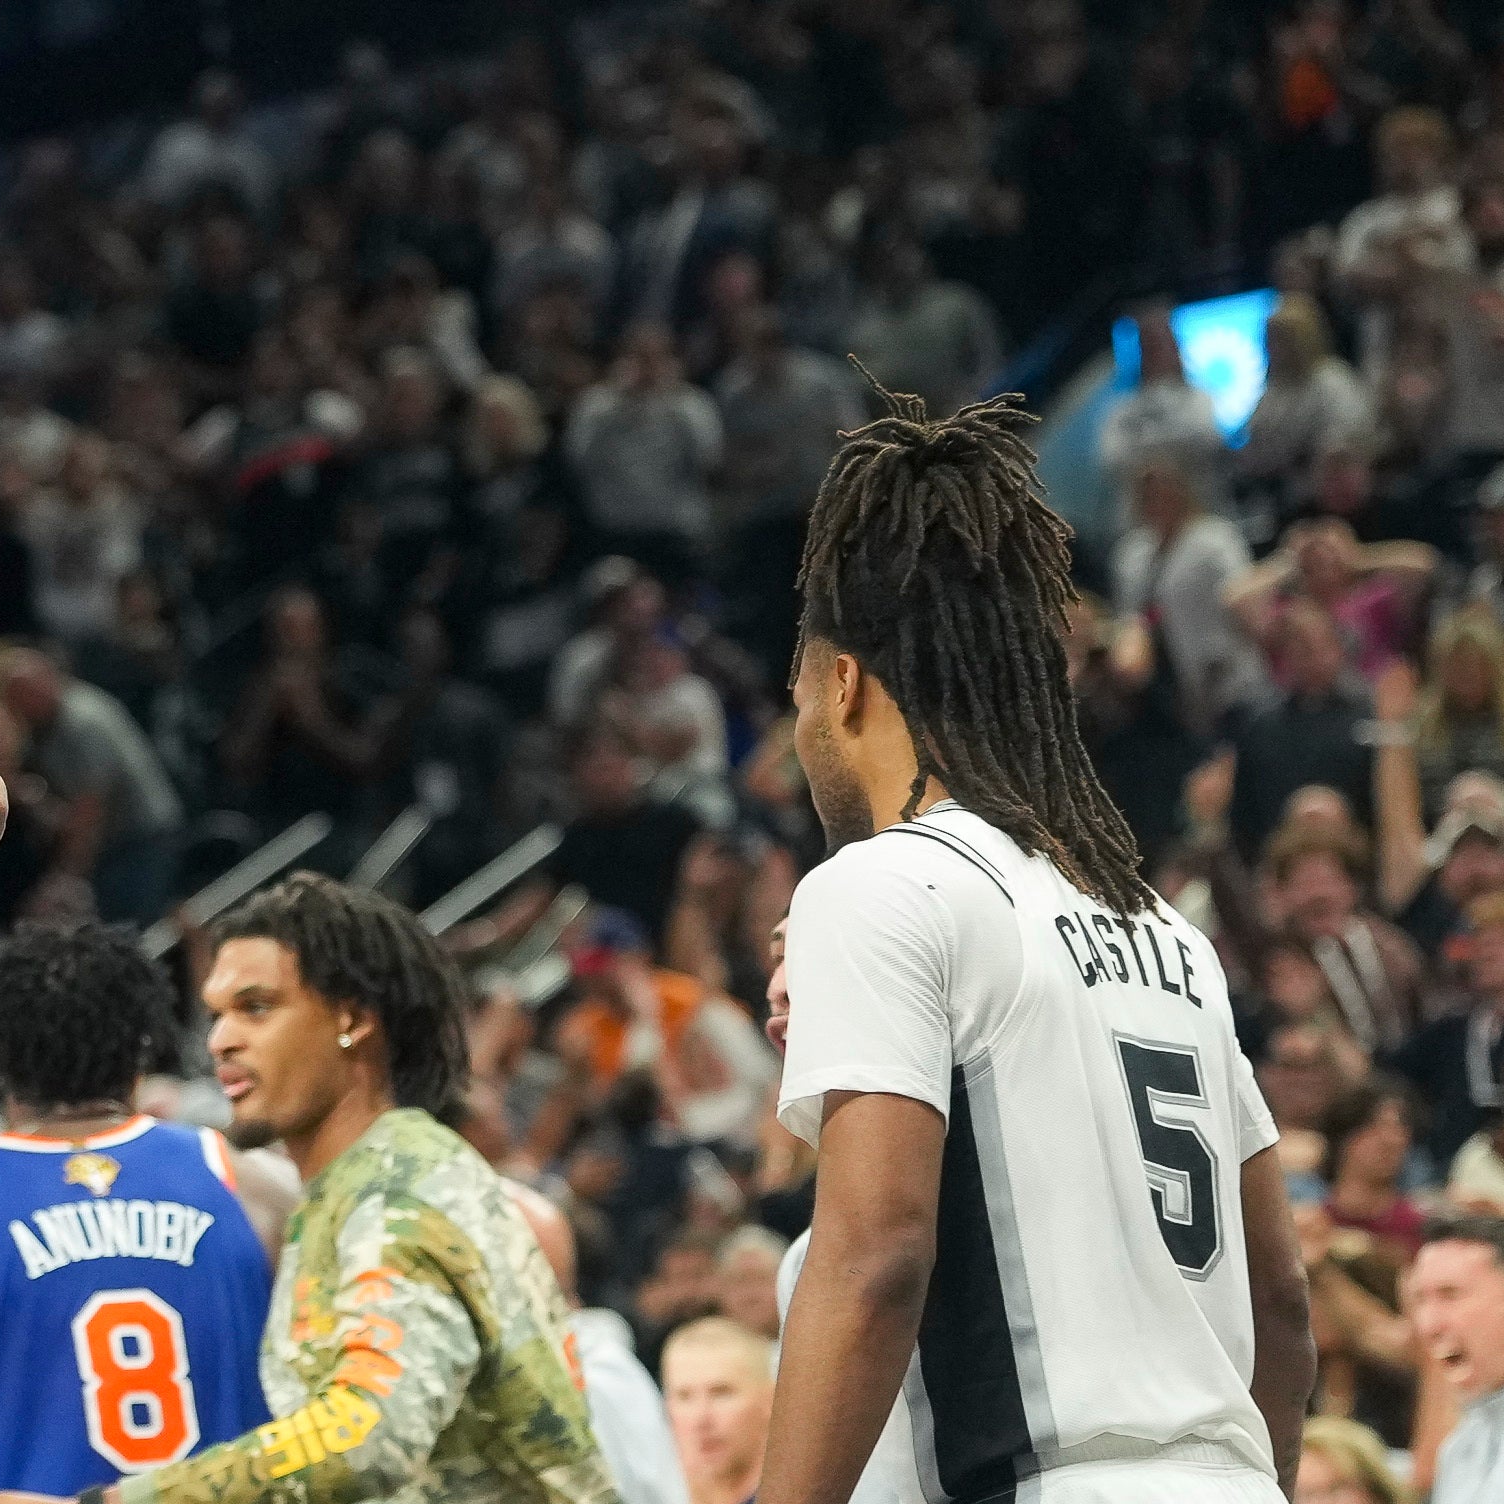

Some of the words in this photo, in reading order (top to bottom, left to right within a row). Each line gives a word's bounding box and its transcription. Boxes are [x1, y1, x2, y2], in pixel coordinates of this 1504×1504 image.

[1055, 912, 1202, 1009] CASTLE
[1112, 1029, 1224, 1283] 5
[8, 1199, 215, 1280] ANUNOBY
[71, 1288, 200, 1474] 8
